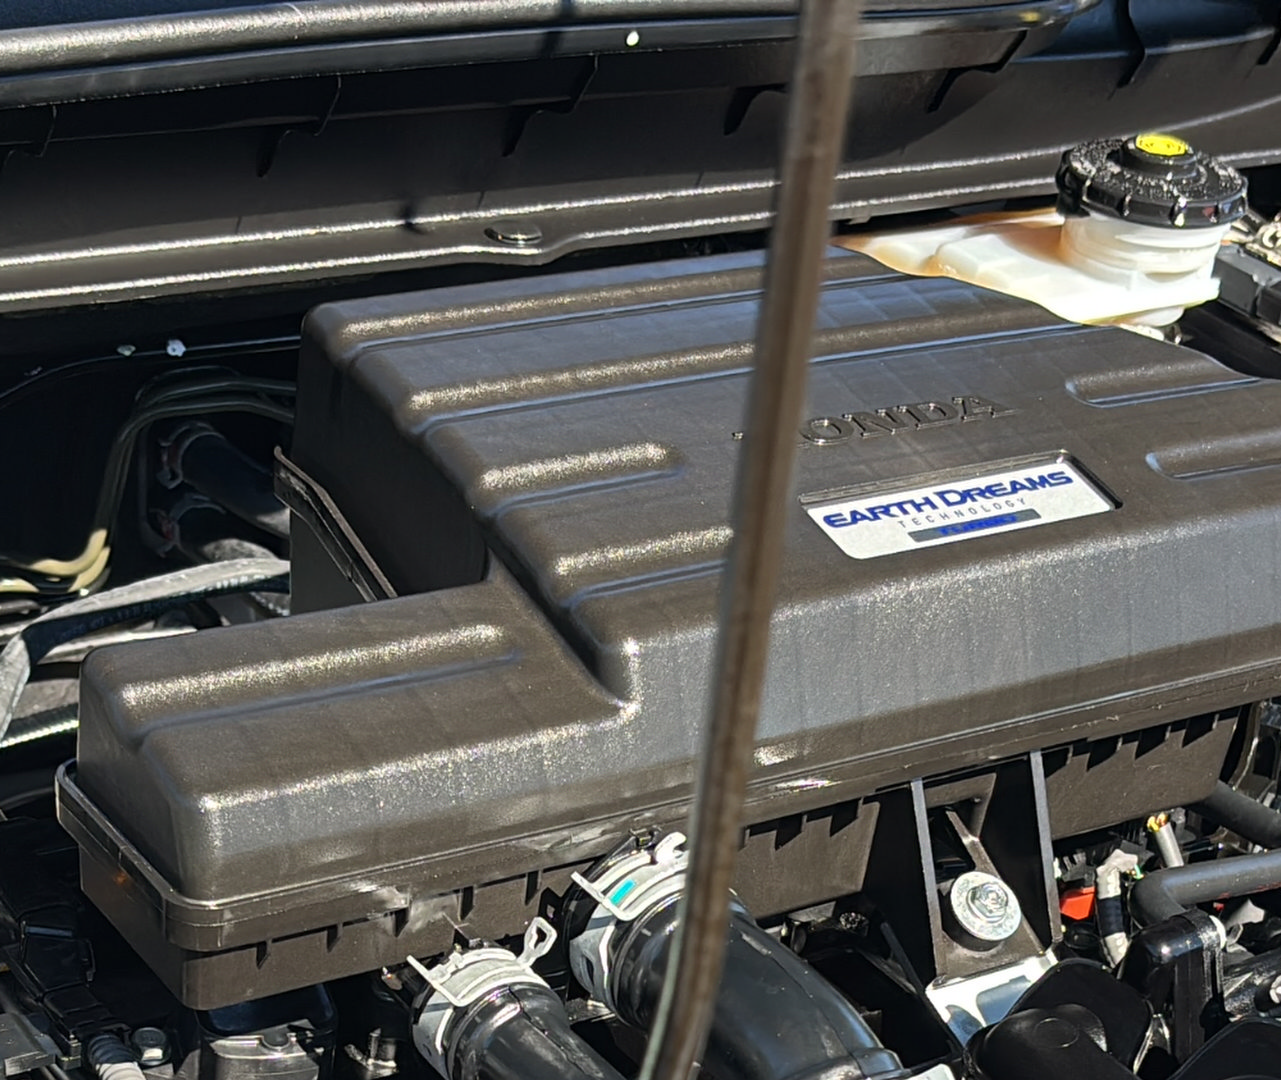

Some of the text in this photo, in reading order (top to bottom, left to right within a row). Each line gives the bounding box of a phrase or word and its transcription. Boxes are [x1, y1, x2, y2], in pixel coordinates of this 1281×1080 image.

[732, 394, 1018, 446] ONDA
[823, 471, 1074, 528] EARTH DREAMS
[897, 497, 1028, 529] TECHNOLOGY
